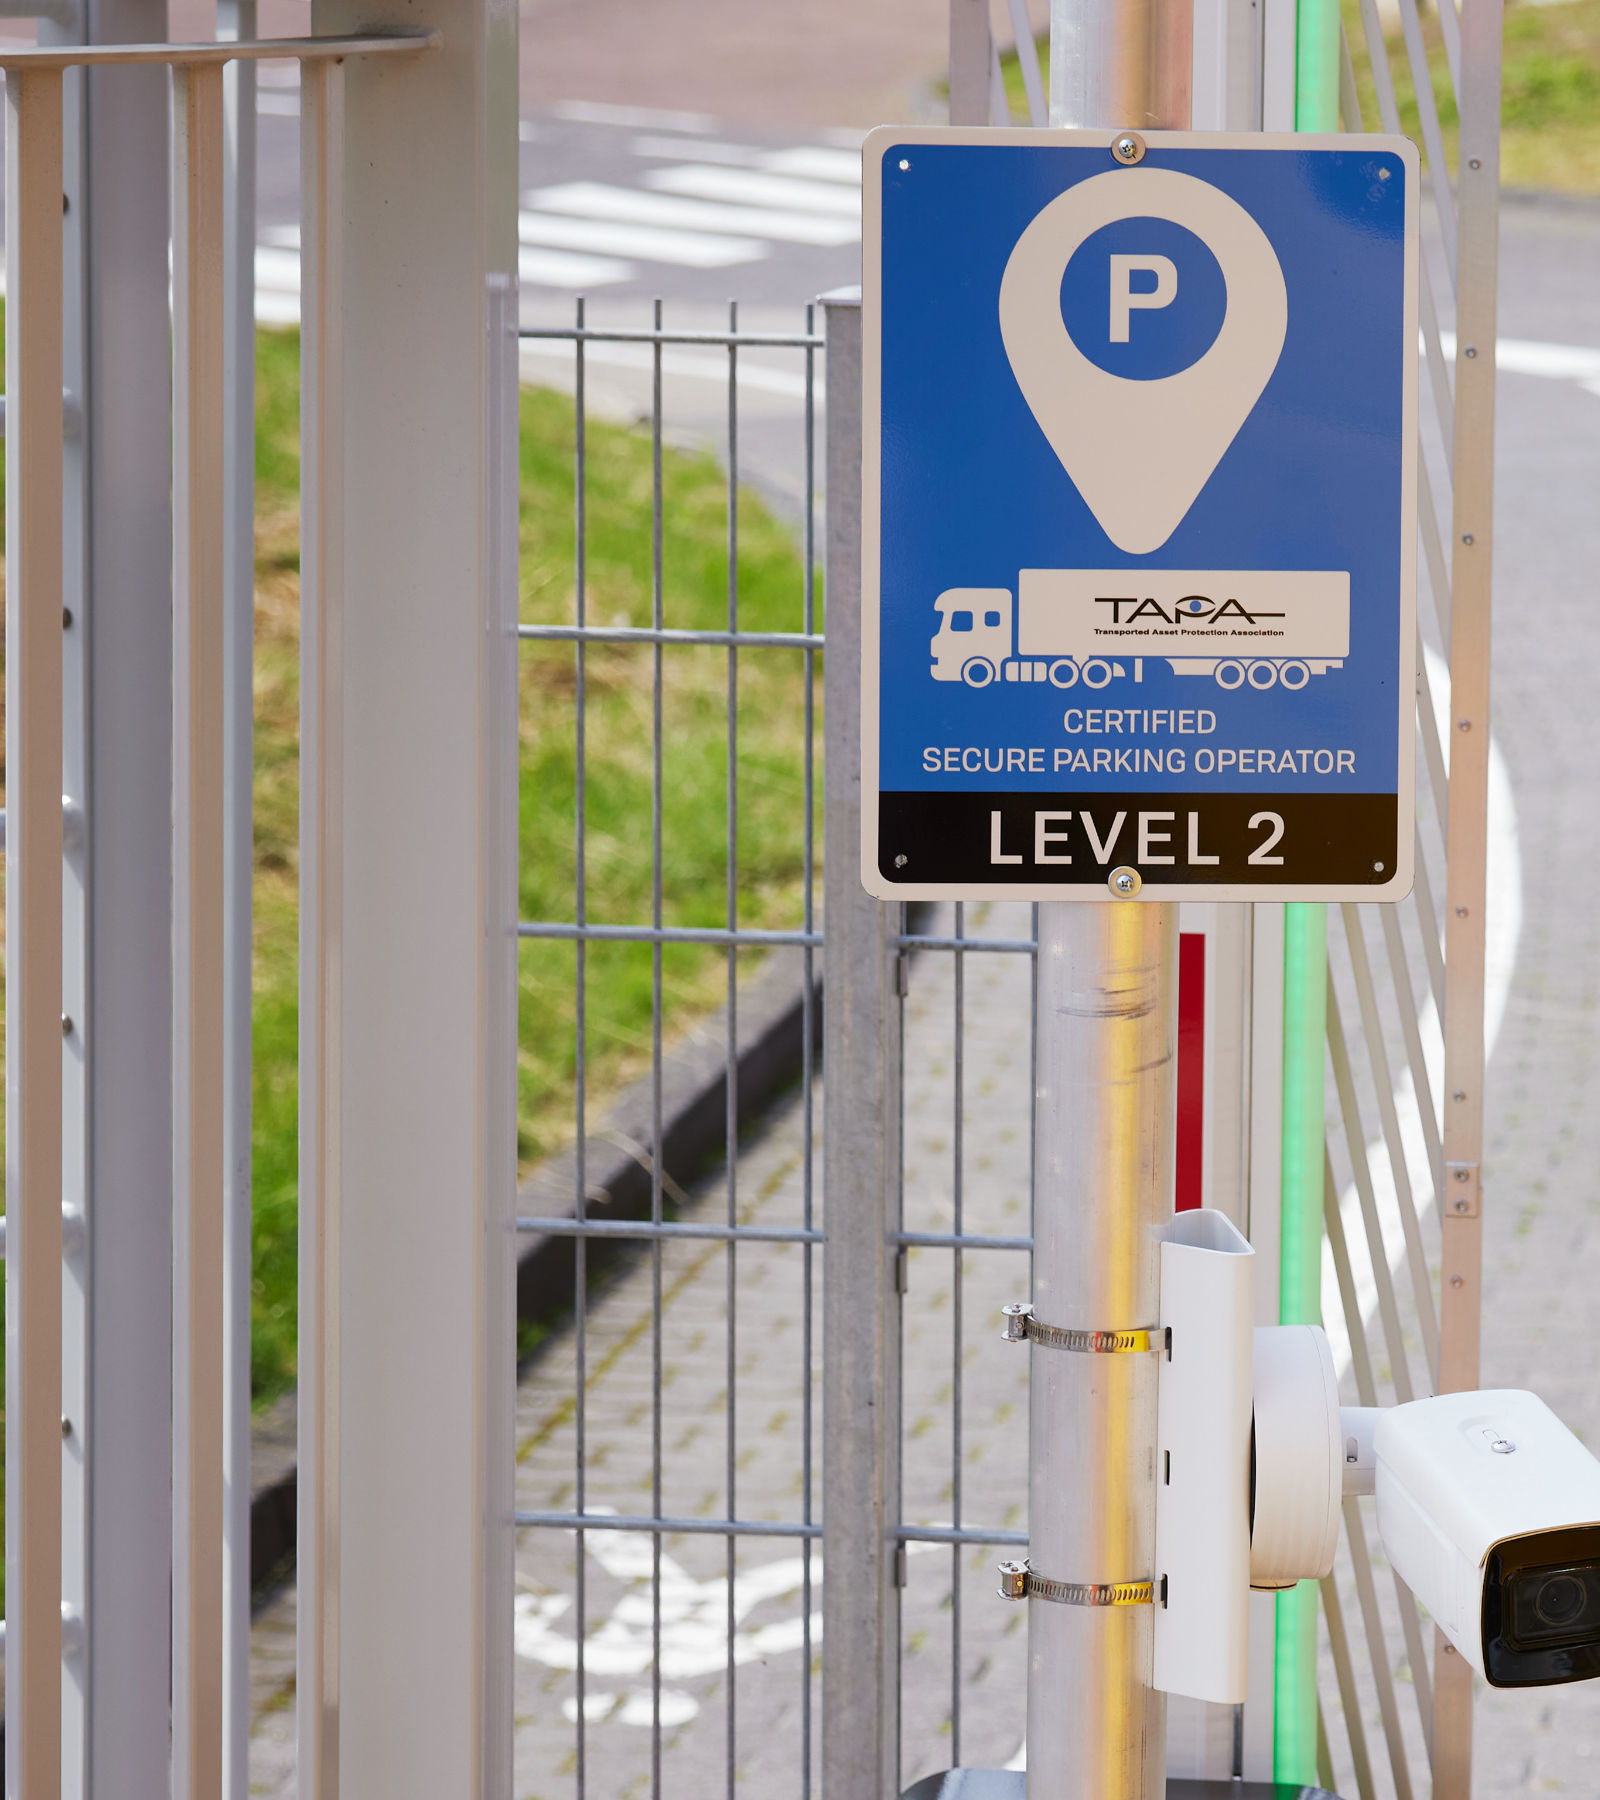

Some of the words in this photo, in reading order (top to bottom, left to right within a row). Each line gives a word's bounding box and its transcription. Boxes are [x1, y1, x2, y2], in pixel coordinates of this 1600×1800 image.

[1109, 254, 1179, 343] P
[1095, 595, 1286, 624] TAPA
[1094, 628, 1150, 636] Transported
[1152, 628, 1178, 636] Asset
[1181, 629, 1228, 637] Protection
[1230, 629, 1284, 637] Association
[1063, 708, 1217, 734] CERTIFIED
[922, 747, 1046, 773] SECURE
[1053, 748, 1186, 773] PARKING
[1194, 749, 1356, 774] OPERATOR
[990, 810, 1220, 865] LEVEL
[1247, 811, 1286, 865] 2
